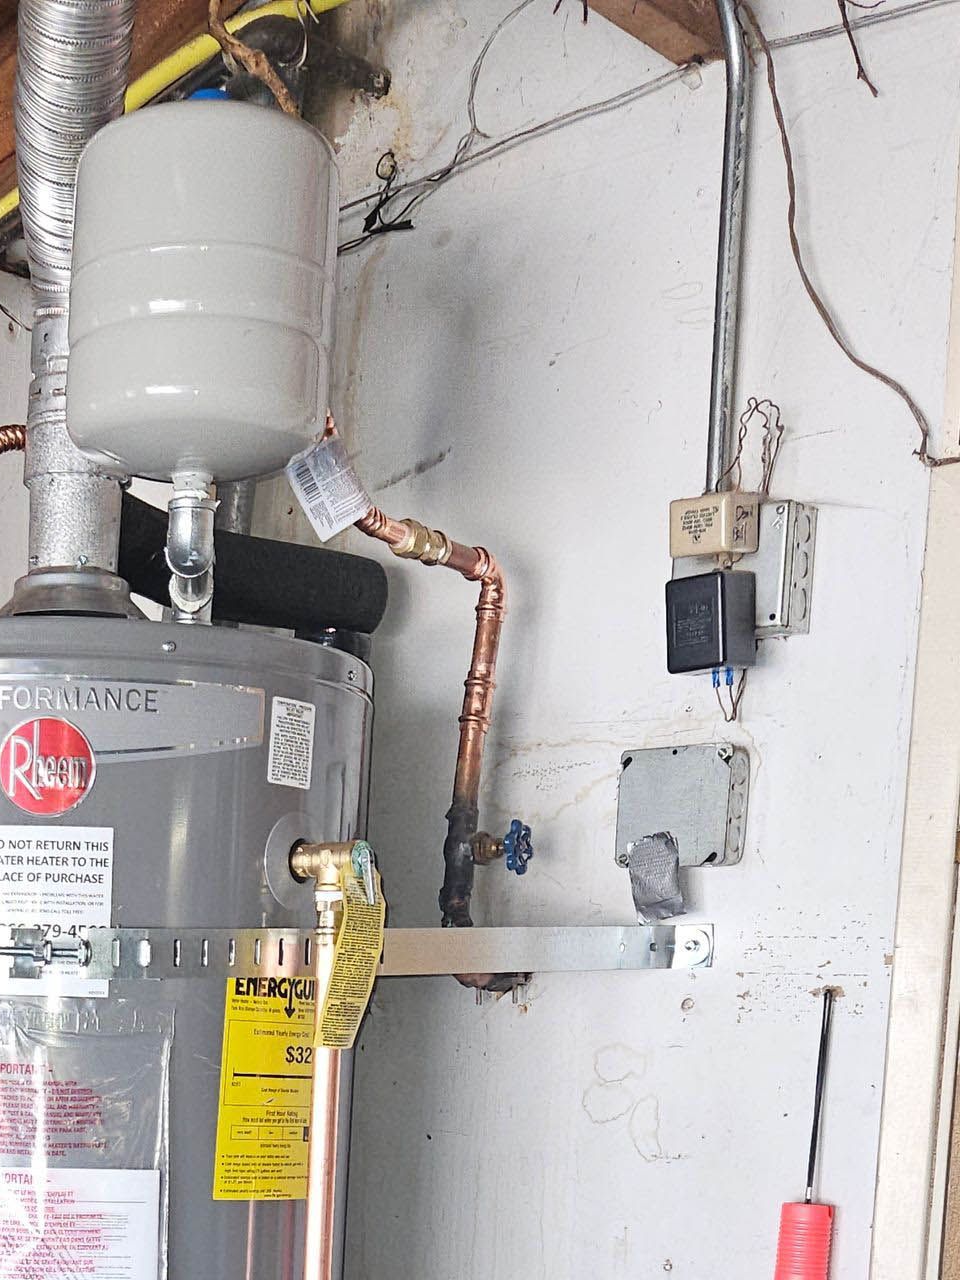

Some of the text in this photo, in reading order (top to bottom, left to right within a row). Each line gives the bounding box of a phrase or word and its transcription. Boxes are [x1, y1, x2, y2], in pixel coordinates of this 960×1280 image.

[8, 720, 88, 801] Rheem
[8, 840, 32, 850] NOT
[36, 840, 81, 851] RETURN
[85, 842, 109, 851] THIS
[27, 856, 69, 866] HEATER
[71, 857, 86, 867] TO
[89, 858, 109, 867] THE
[27, 872, 41, 882] OF
[45, 873, 104, 884] PURCHASE
[235, 977, 314, 1001] ENERGYGUI
